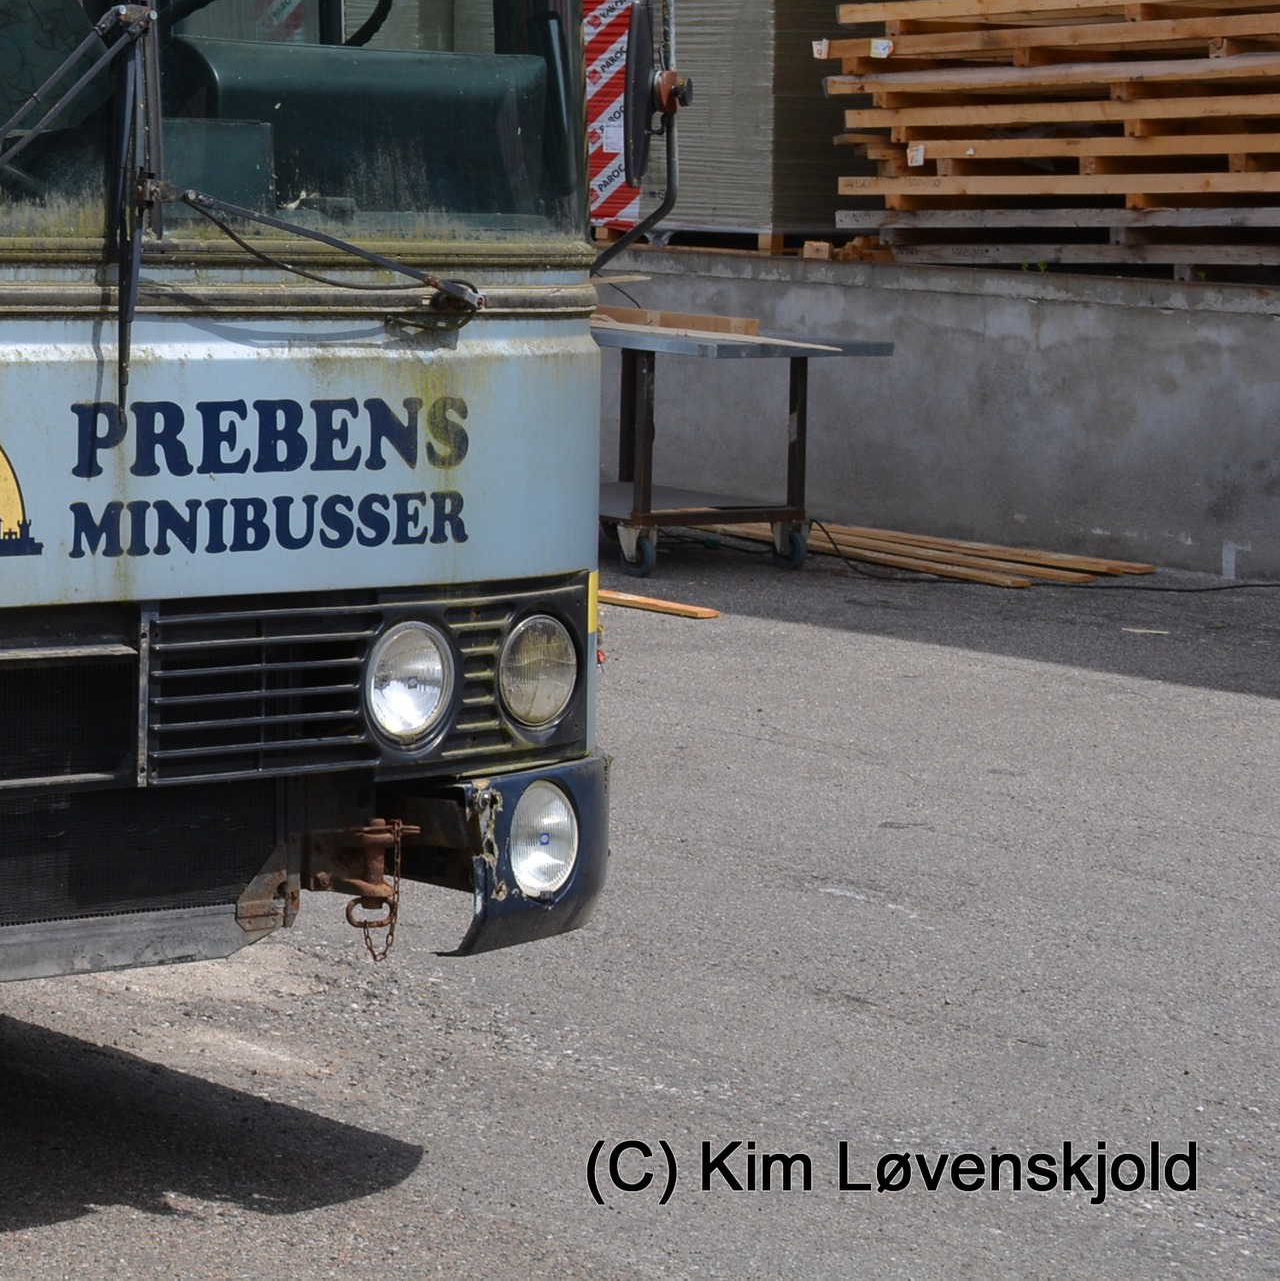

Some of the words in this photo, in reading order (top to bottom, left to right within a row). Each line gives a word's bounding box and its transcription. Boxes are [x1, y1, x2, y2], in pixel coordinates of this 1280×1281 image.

[600, 45, 628, 73] PAROC
[599, 105, 624, 134] PROC
[597, 164, 625, 193] PAROC
[70, 396, 469, 479] PREBENS
[69, 490, 469, 560] MINIBUSSER
